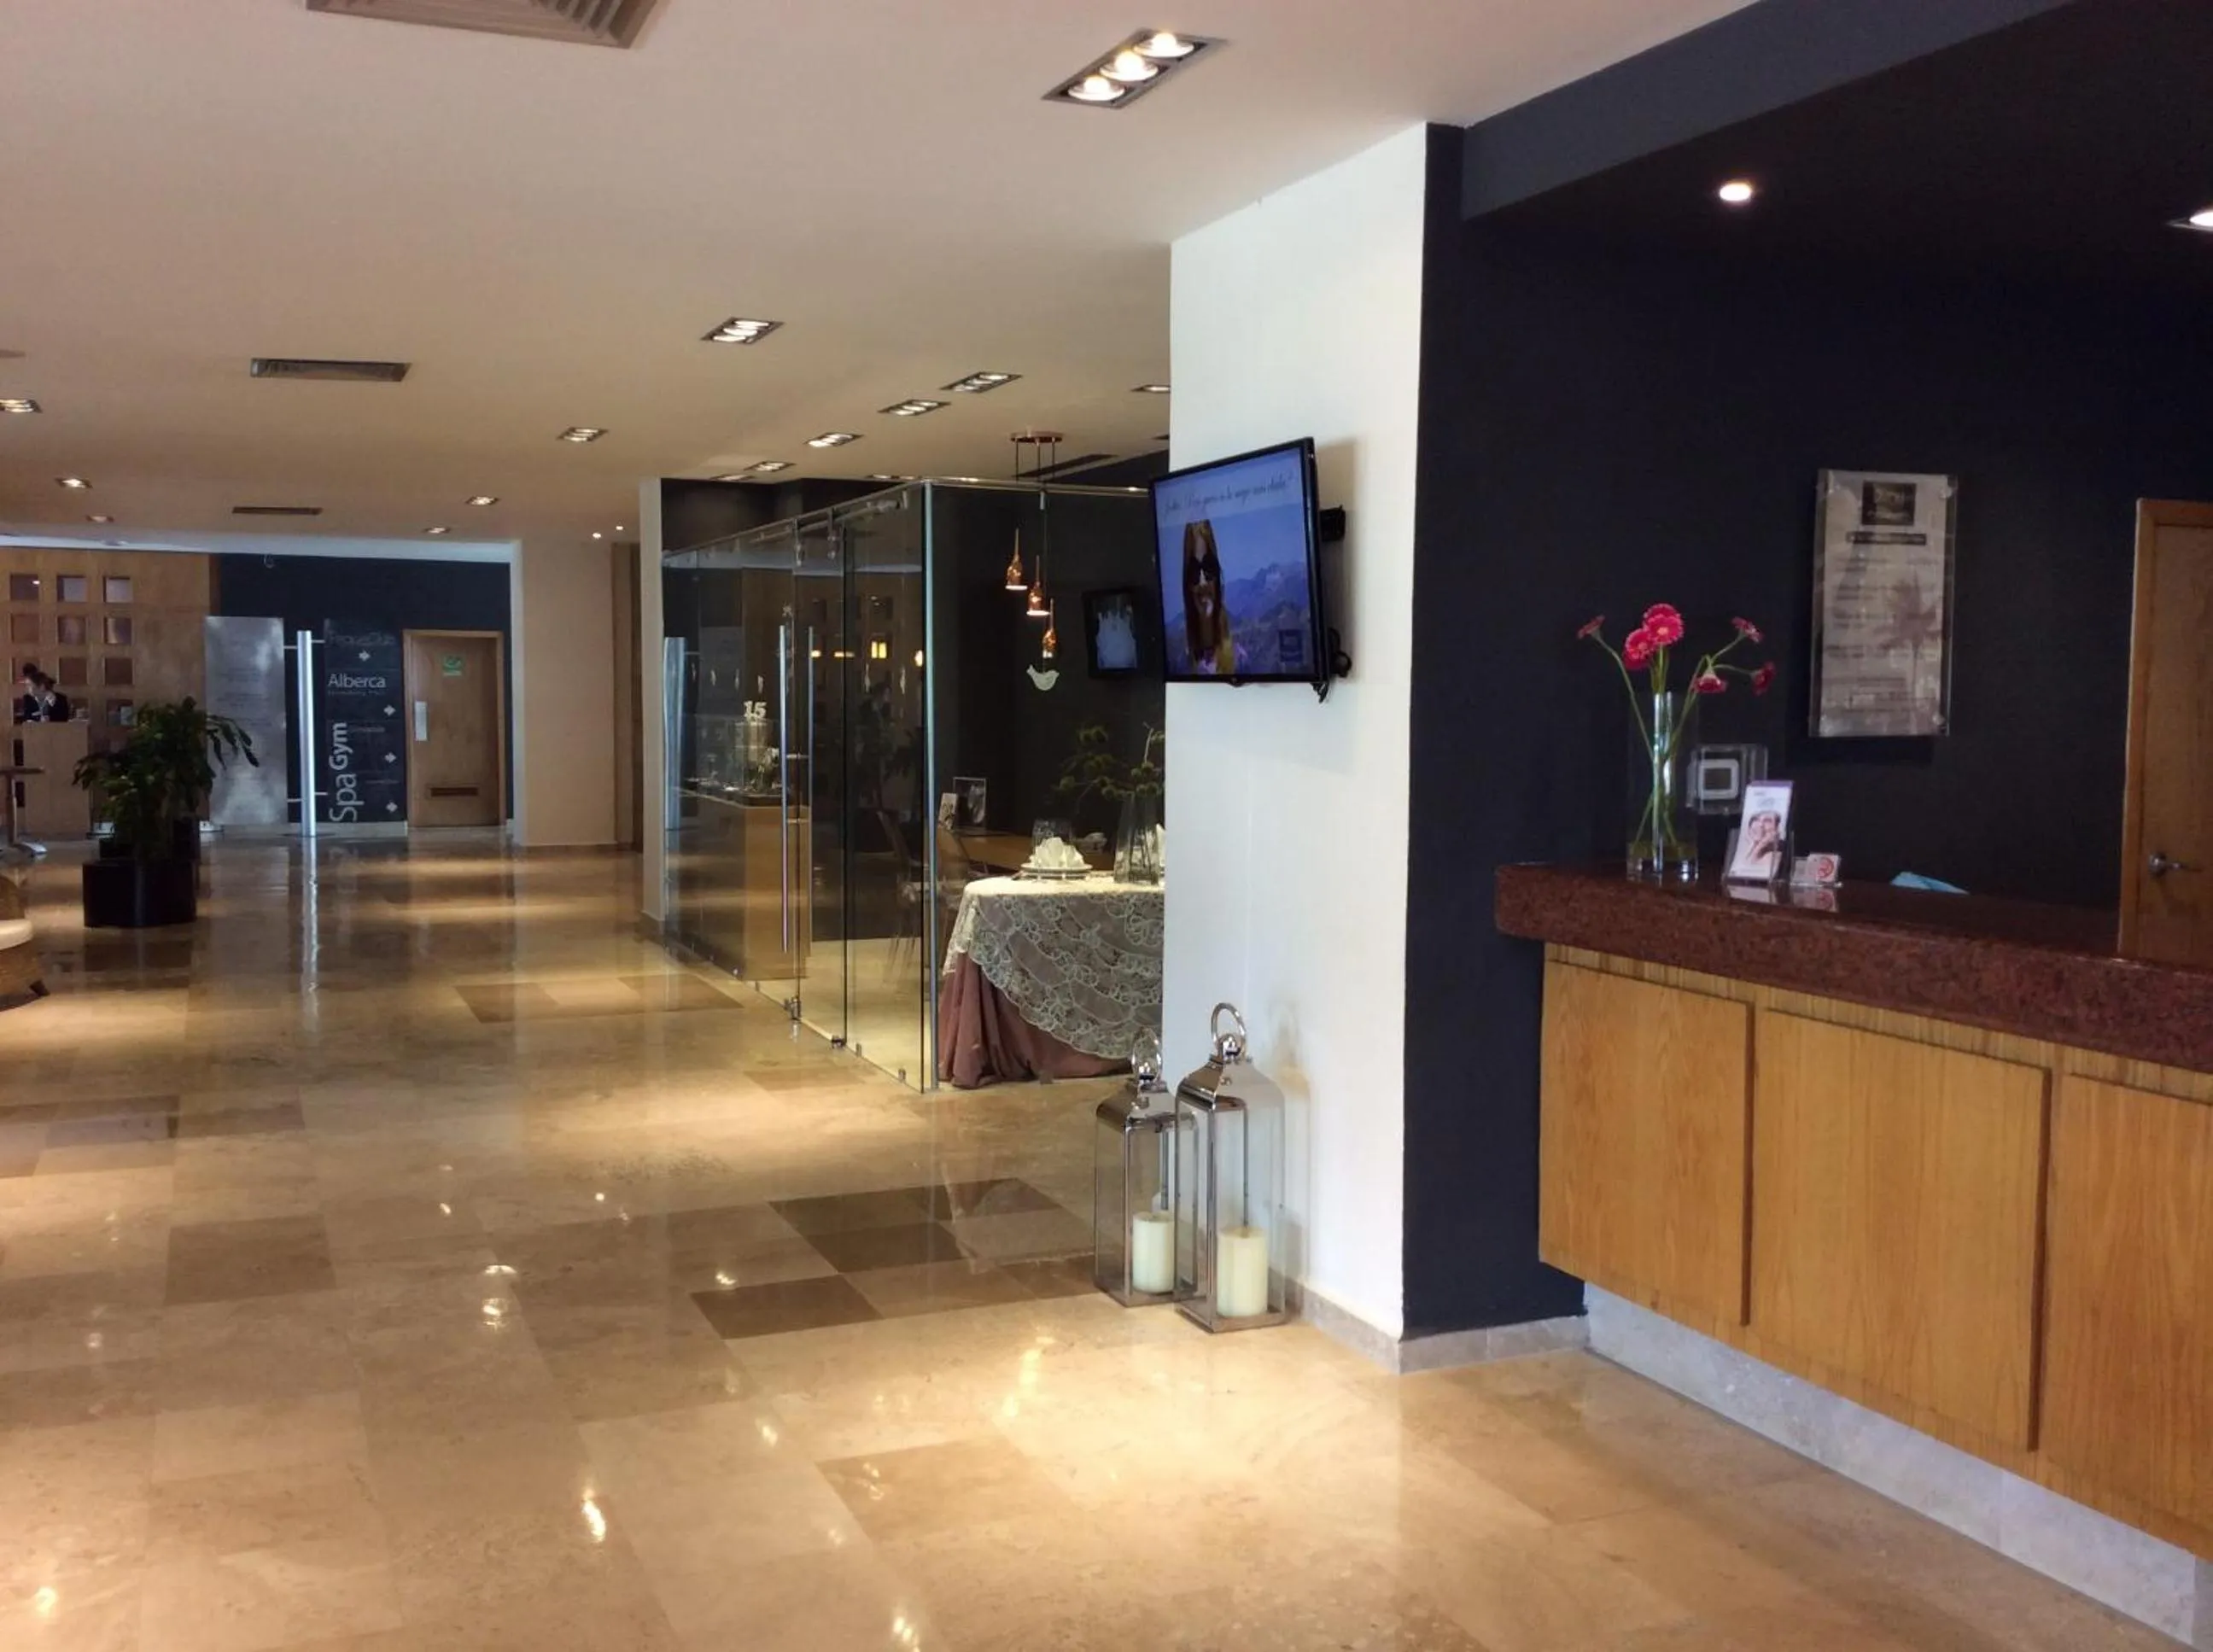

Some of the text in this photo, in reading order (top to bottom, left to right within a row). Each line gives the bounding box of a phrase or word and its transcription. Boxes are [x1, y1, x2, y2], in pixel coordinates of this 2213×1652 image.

[328, 673, 387, 688] Alberca
[744, 700, 767, 718] 15
[329, 721, 365, 821] Spa Gym
